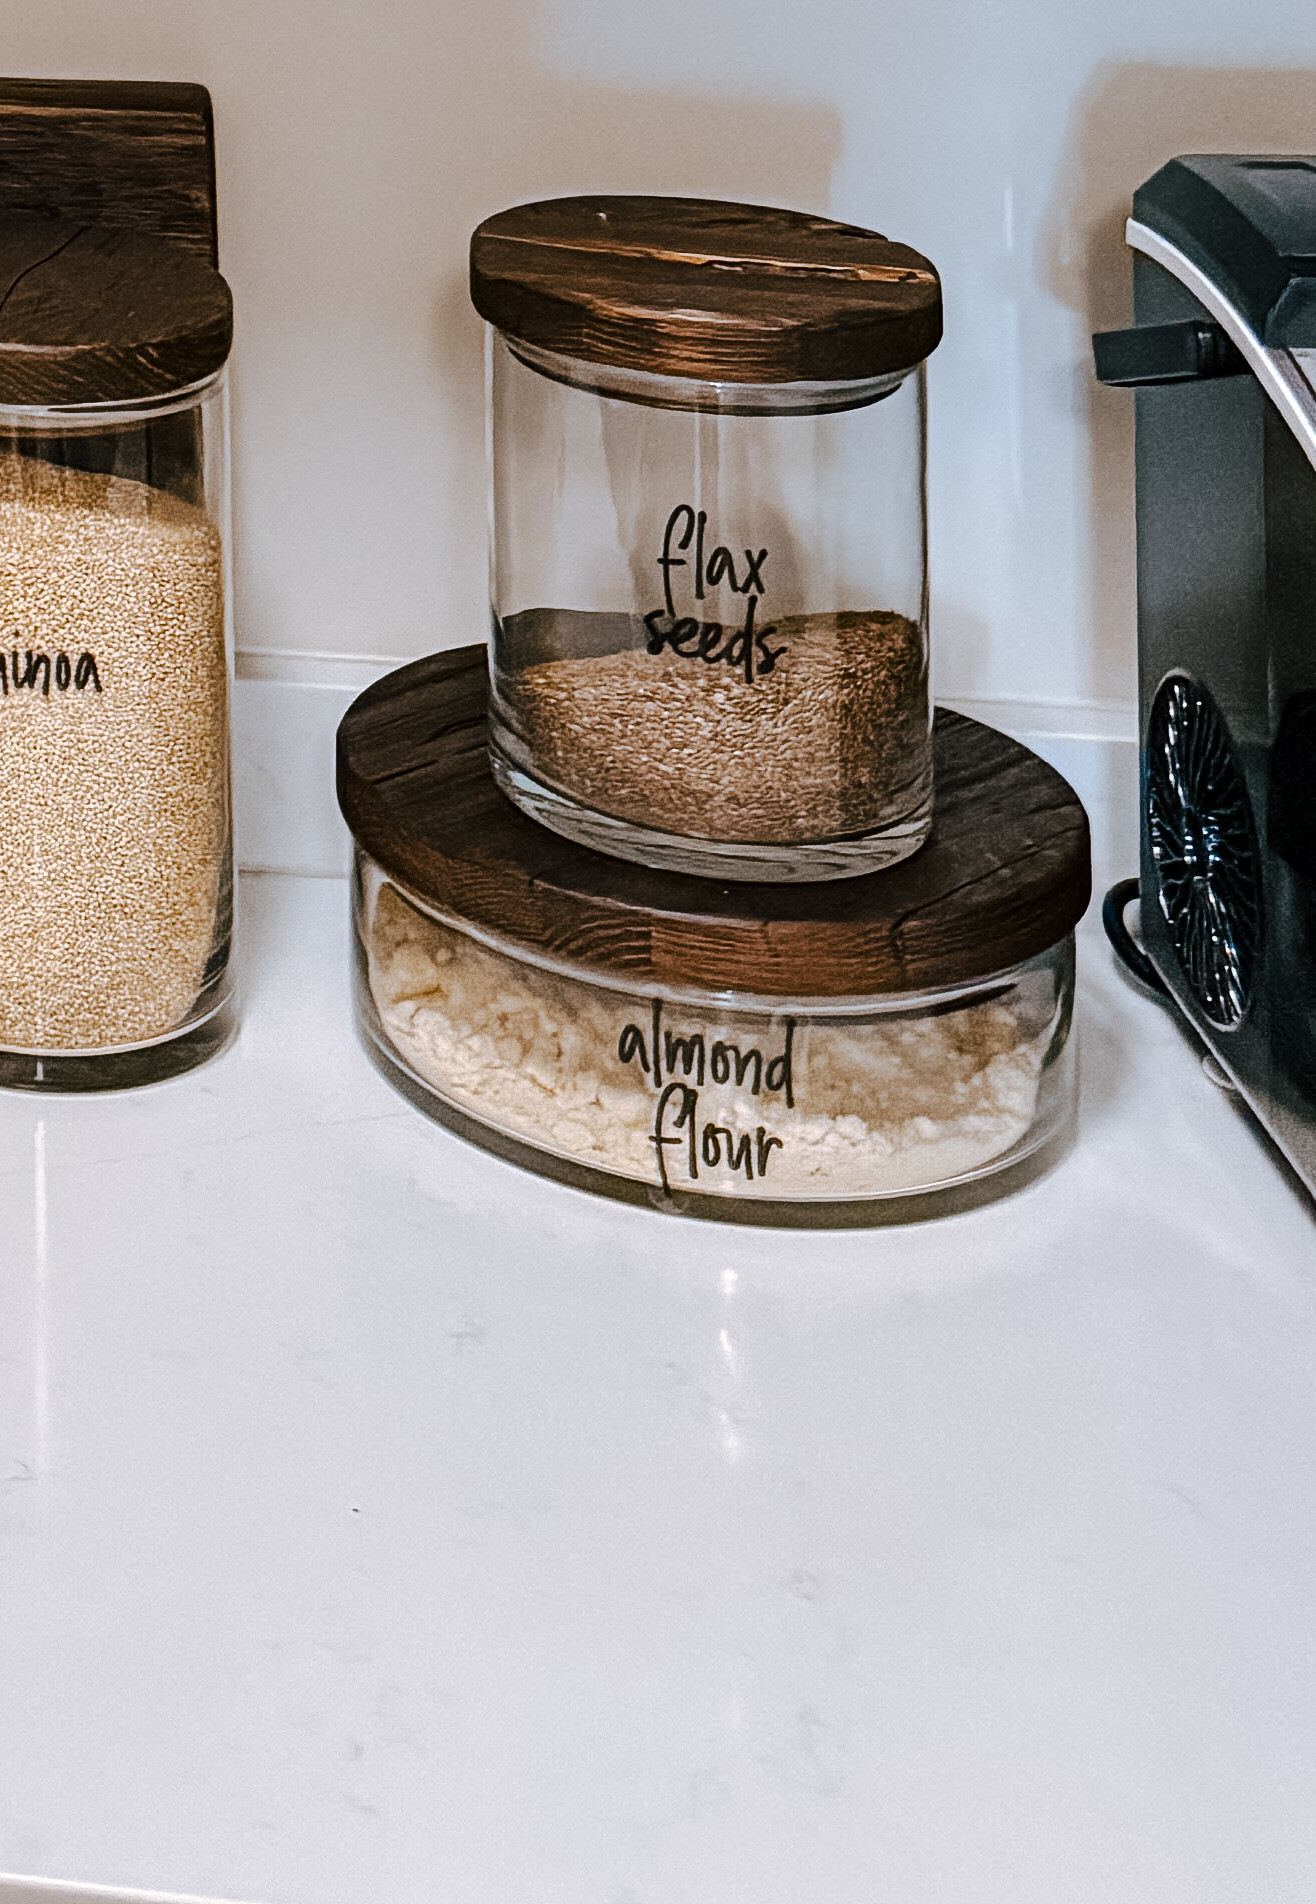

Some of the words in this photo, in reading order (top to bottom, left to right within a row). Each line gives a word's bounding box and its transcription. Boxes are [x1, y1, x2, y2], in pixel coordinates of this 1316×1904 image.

[657, 504, 768, 618] flax
[643, 594, 788, 684] seeds
[618, 997, 795, 1109] almond
[648, 1082, 784, 1197] flour
